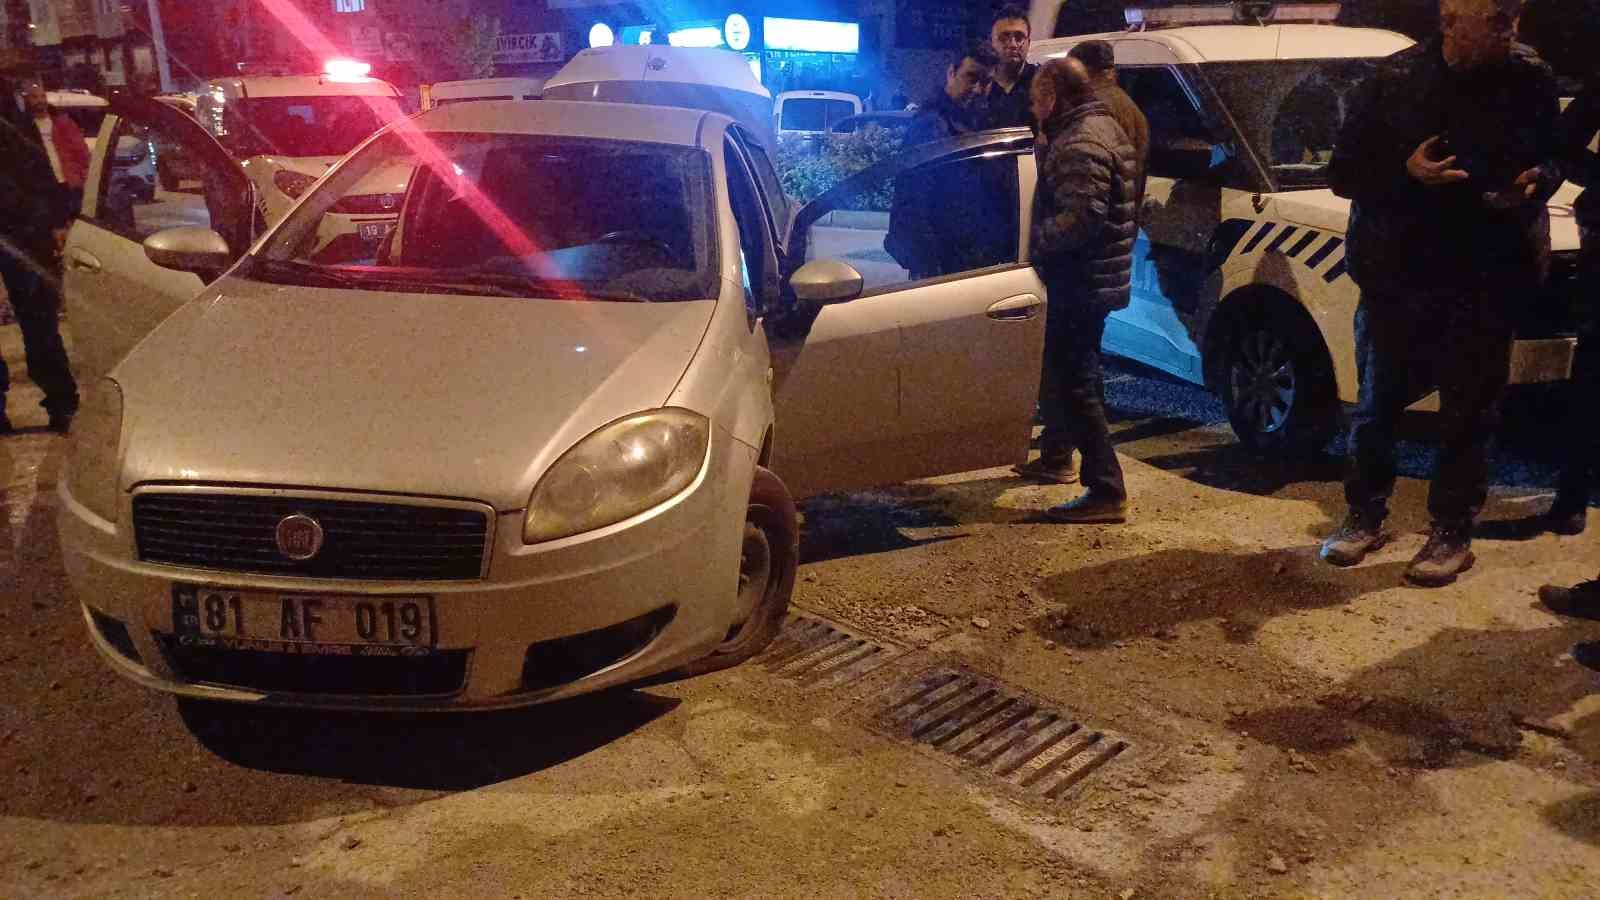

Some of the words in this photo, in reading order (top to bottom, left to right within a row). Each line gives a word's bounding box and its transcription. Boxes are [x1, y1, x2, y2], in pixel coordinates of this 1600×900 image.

[205, 593, 242, 632] 81
[280, 598, 321, 640] AF
[356, 601, 421, 641] 019
